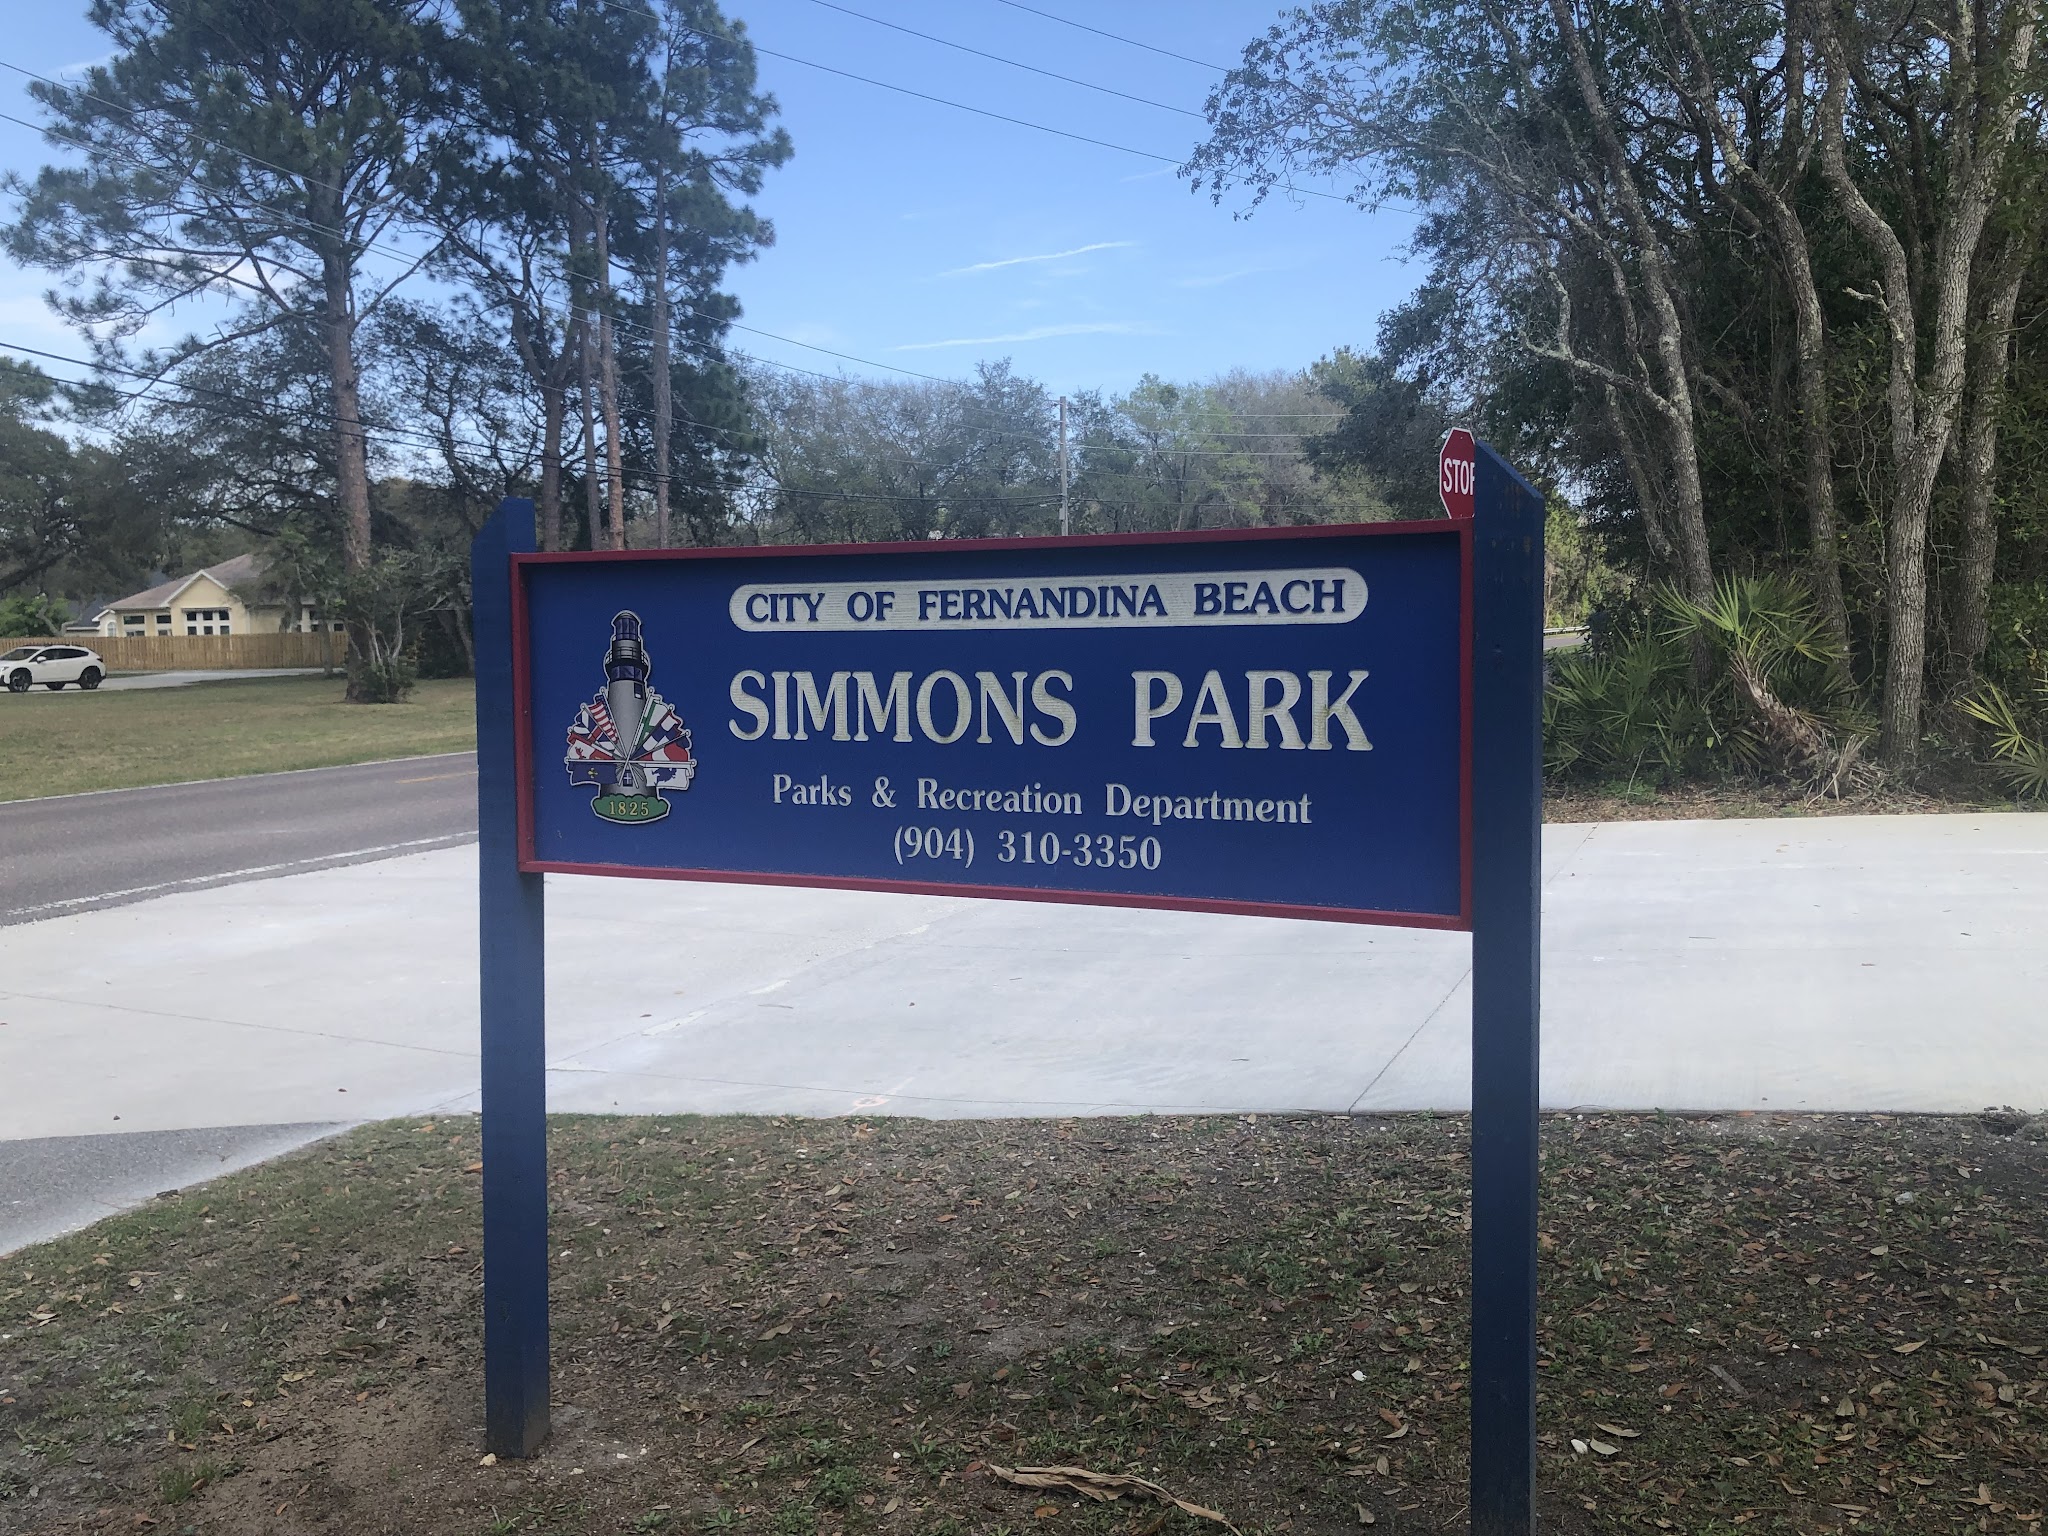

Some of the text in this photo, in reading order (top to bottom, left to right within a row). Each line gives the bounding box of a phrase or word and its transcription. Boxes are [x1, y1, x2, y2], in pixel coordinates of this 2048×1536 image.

[745, 578, 1346, 624] CITY OF FERNANDINA BEACH
[728, 669, 1373, 751] SIMMONS PARK
[609, 801, 649, 816] 1825
[772, 773, 1312, 826] Parks & Recreation Department
[894, 826, 1162, 870] (904) 310-3350
